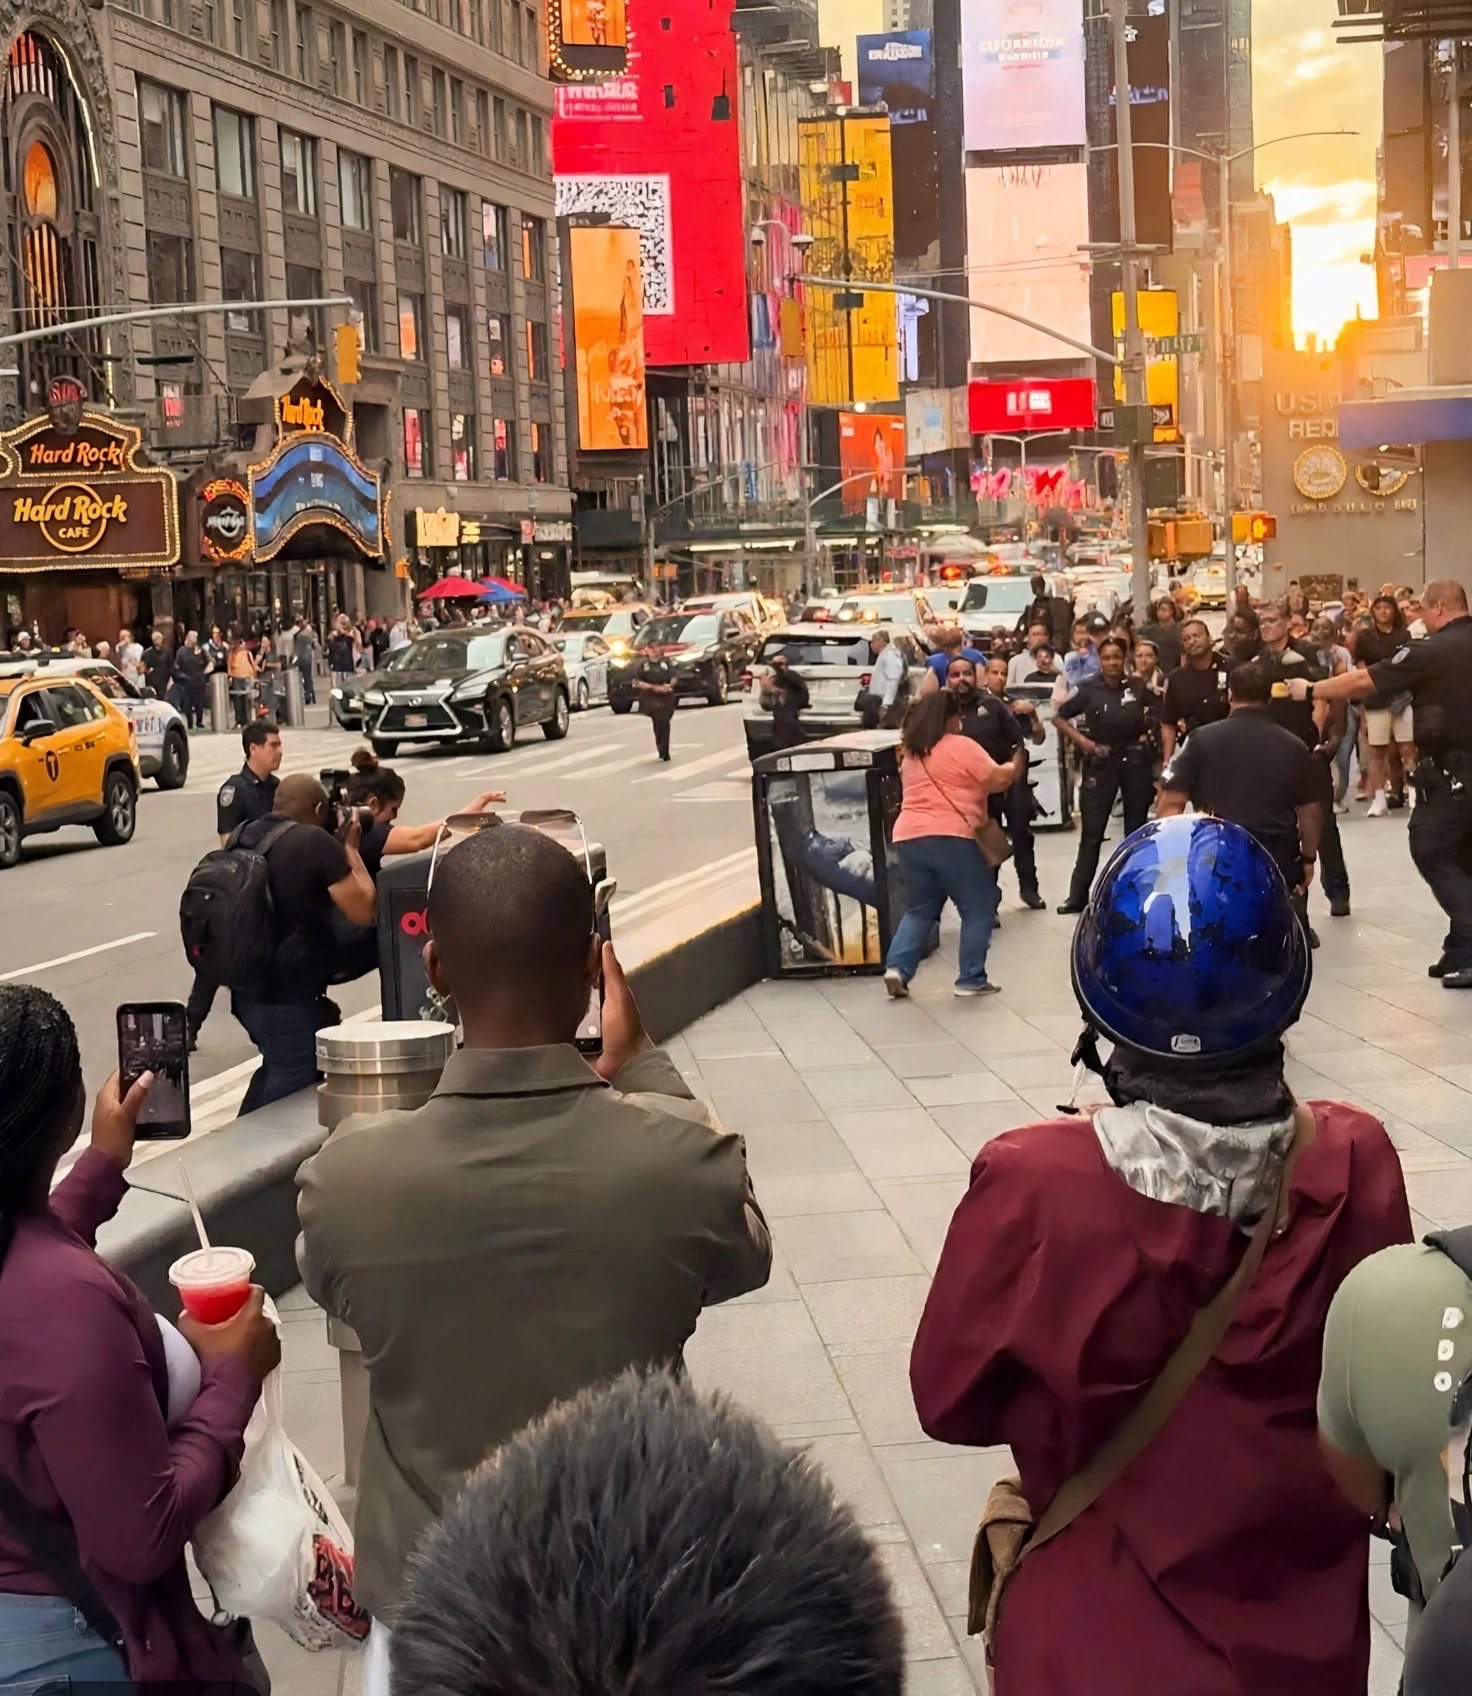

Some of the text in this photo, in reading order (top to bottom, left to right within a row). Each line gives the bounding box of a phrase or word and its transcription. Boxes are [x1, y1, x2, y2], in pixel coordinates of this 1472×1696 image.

[29, 441, 121, 467] Hard Rock
[13, 494, 128, 525] Hard Rock
[58, 526, 91, 539] CAFE
